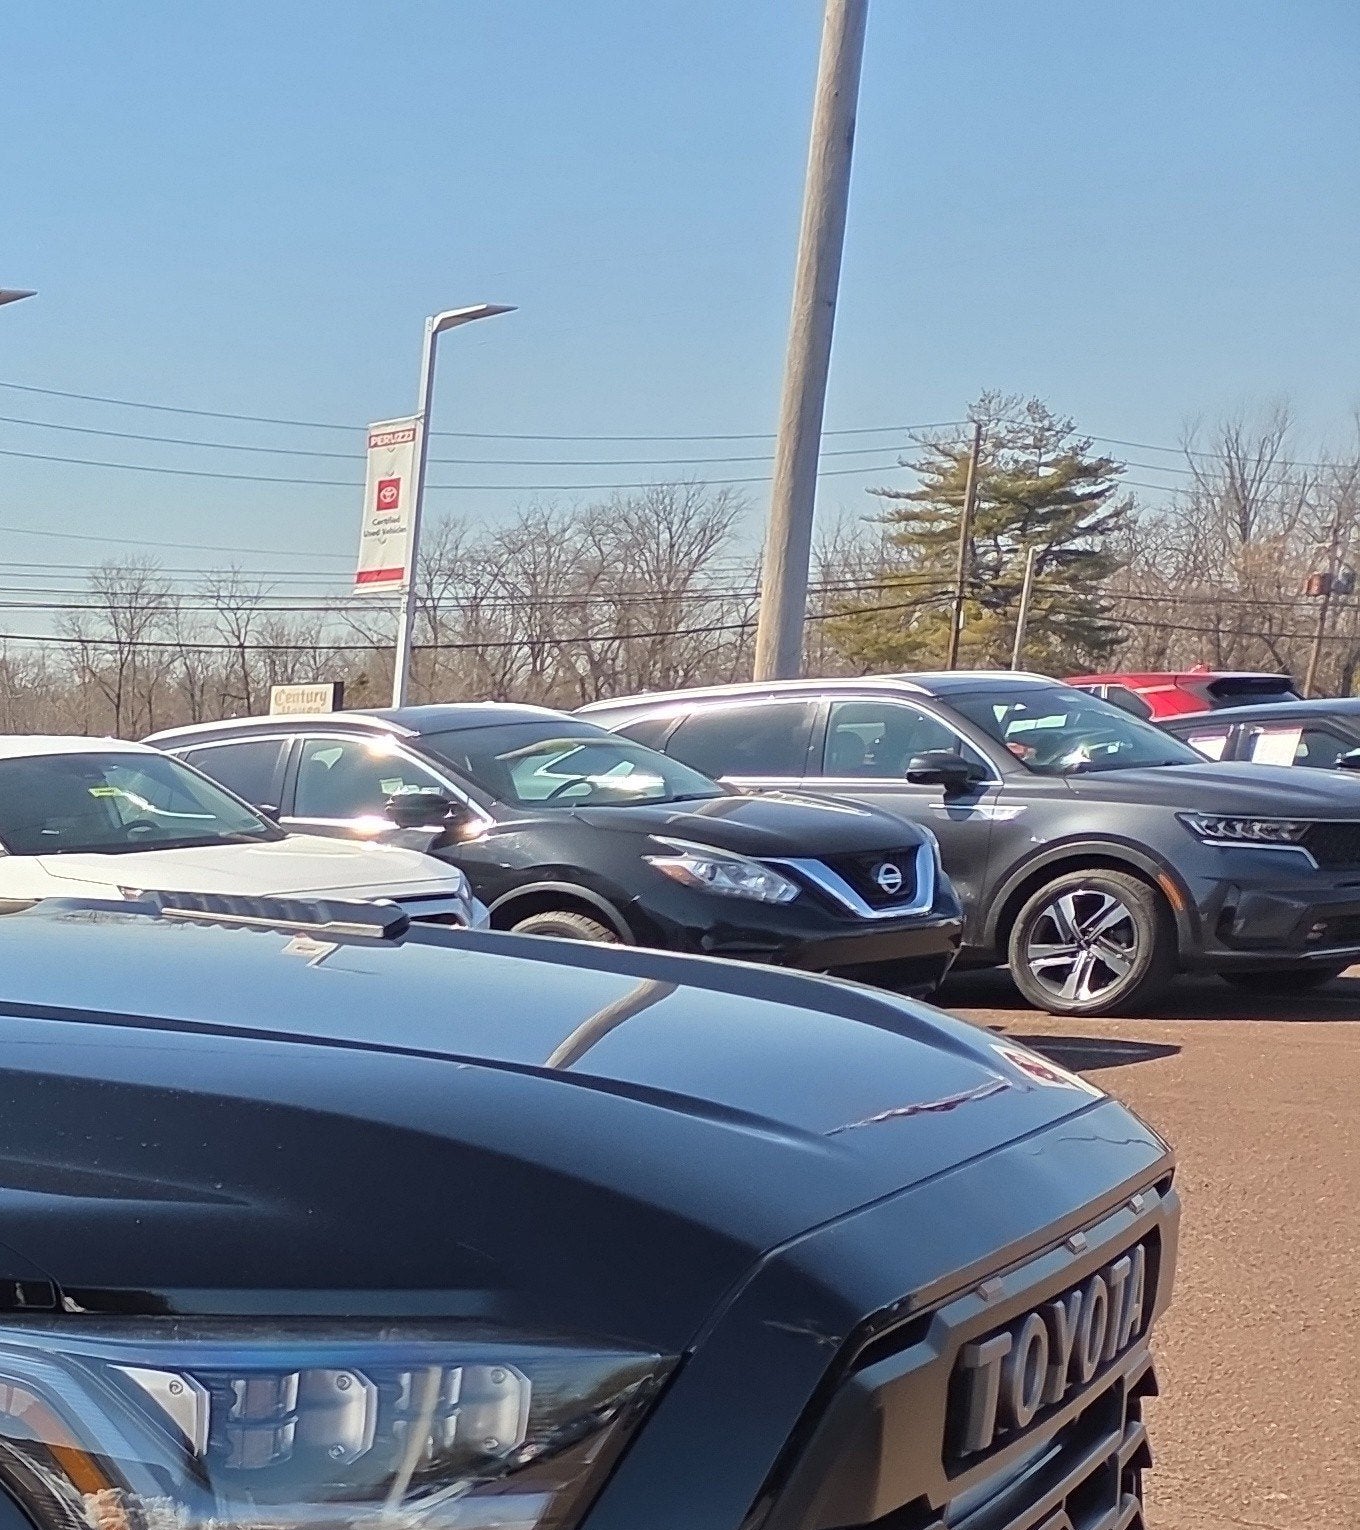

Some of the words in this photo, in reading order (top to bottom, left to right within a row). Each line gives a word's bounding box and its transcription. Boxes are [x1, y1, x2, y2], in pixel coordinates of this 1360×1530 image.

[371, 431, 413, 446] PERUZZI
[372, 515, 400, 525] Certified
[274, 689, 327, 706] Century
[962, 1244, 1145, 1456] TOYOTA
